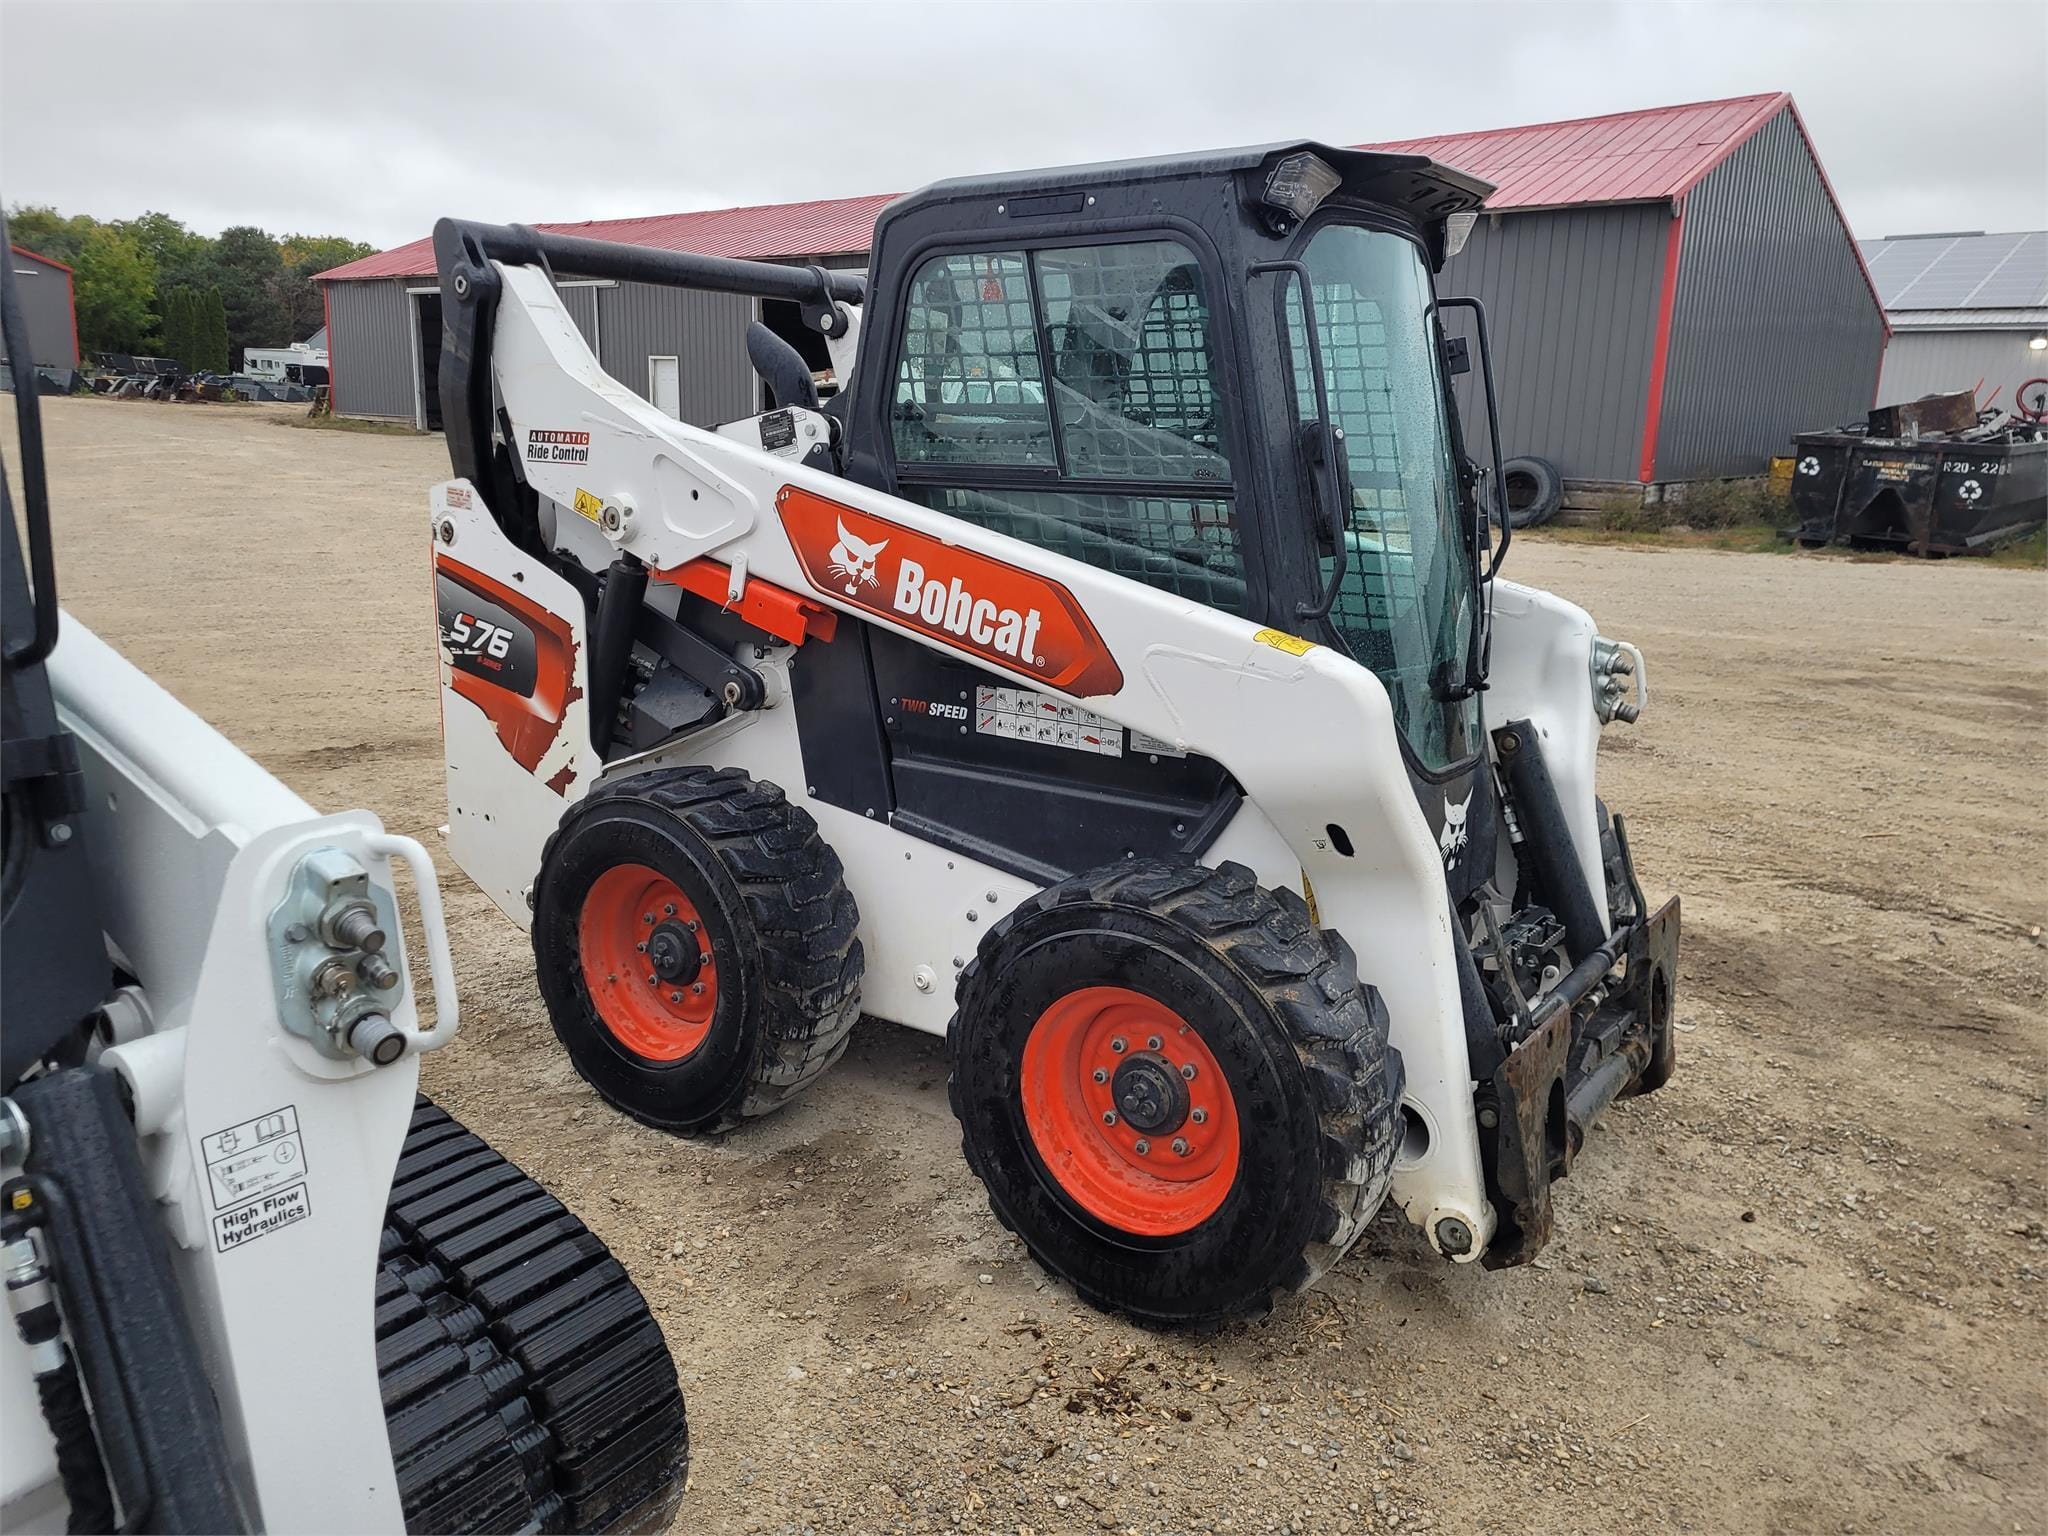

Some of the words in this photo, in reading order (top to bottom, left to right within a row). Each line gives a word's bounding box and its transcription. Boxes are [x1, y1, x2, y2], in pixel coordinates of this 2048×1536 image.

[527, 444, 549, 459] Ride
[552, 445, 589, 461] Control
[530, 431, 588, 444] AUTOMATIC
[893, 557, 1042, 664] Bobcat
[450, 612, 514, 659] S76
[901, 698, 927, 713] TWO
[928, 702, 968, 720] SPEED
[222, 1207, 259, 1229] High
[263, 1191, 299, 1212] Flow
[222, 1204, 305, 1245] Hydraulics
